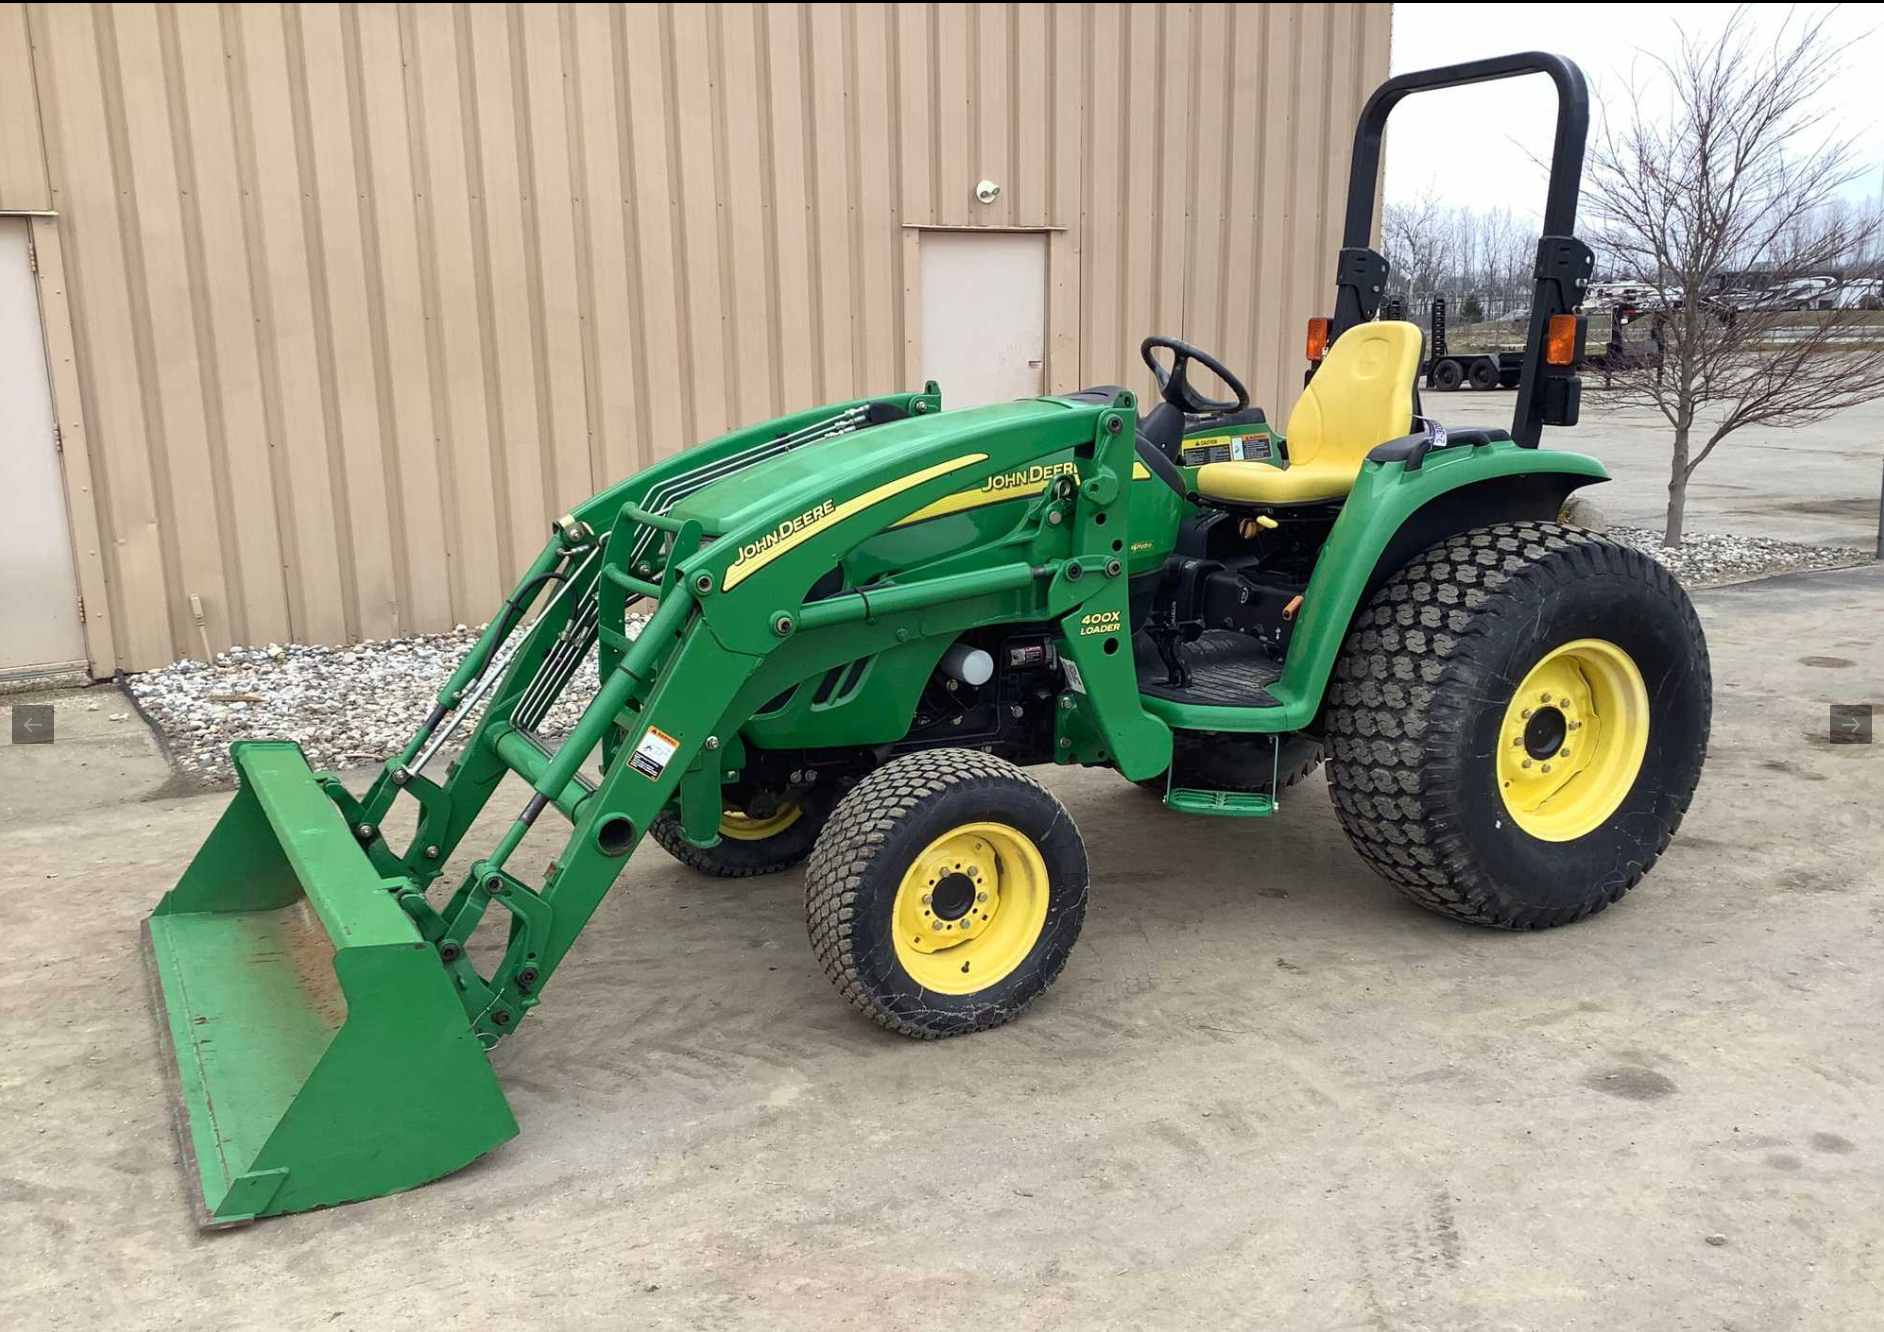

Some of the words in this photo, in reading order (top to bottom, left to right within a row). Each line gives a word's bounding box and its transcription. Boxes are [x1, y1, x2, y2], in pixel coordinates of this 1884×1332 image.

[981, 470, 1028, 492] JOHN
[1028, 462, 1078, 483] DEER
[734, 530, 780, 566] JOHN
[779, 498, 836, 541] DEERE
[1081, 610, 1121, 625] 400X
[1080, 623, 1121, 636] LOADER
